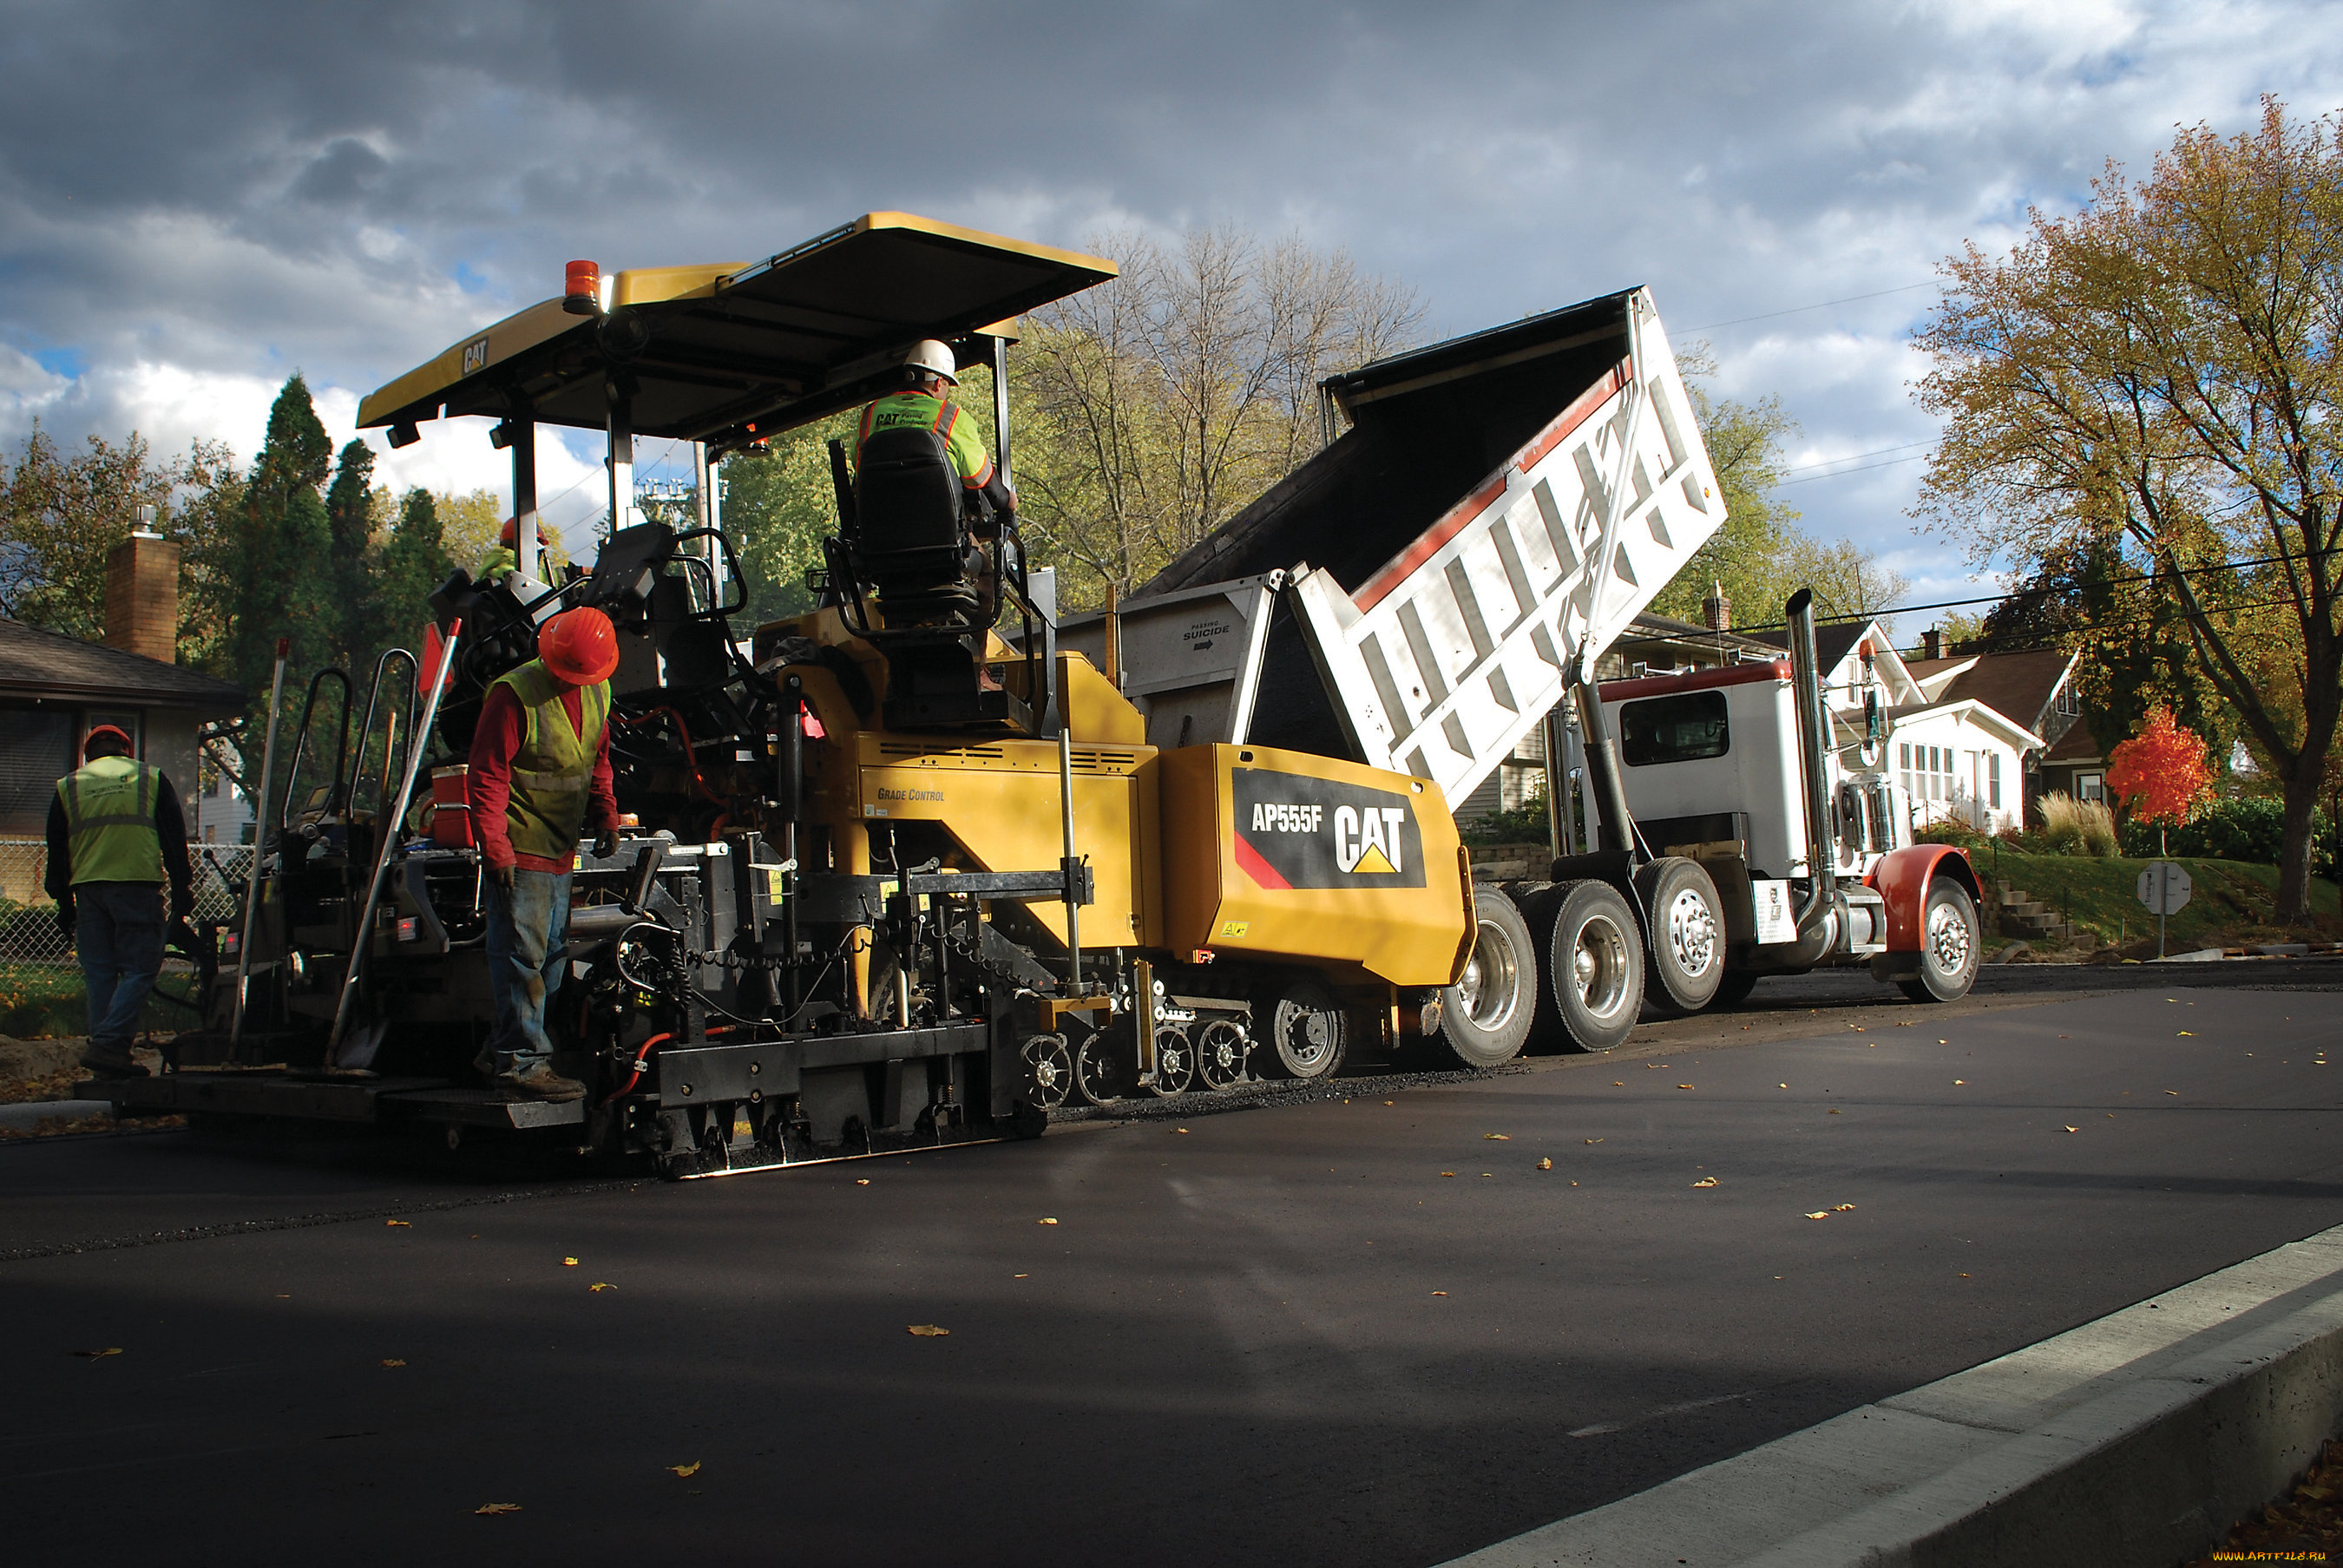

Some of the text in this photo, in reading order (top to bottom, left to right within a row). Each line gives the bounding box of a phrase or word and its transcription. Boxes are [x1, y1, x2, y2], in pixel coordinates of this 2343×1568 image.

[464, 340, 486, 373] CAT
[876, 413, 899, 425] CAT
[1184, 626, 1229, 640] SUICIDE
[878, 788, 944, 801] GRADE CONTROL
[1252, 803, 1405, 874] AP555F CAT
